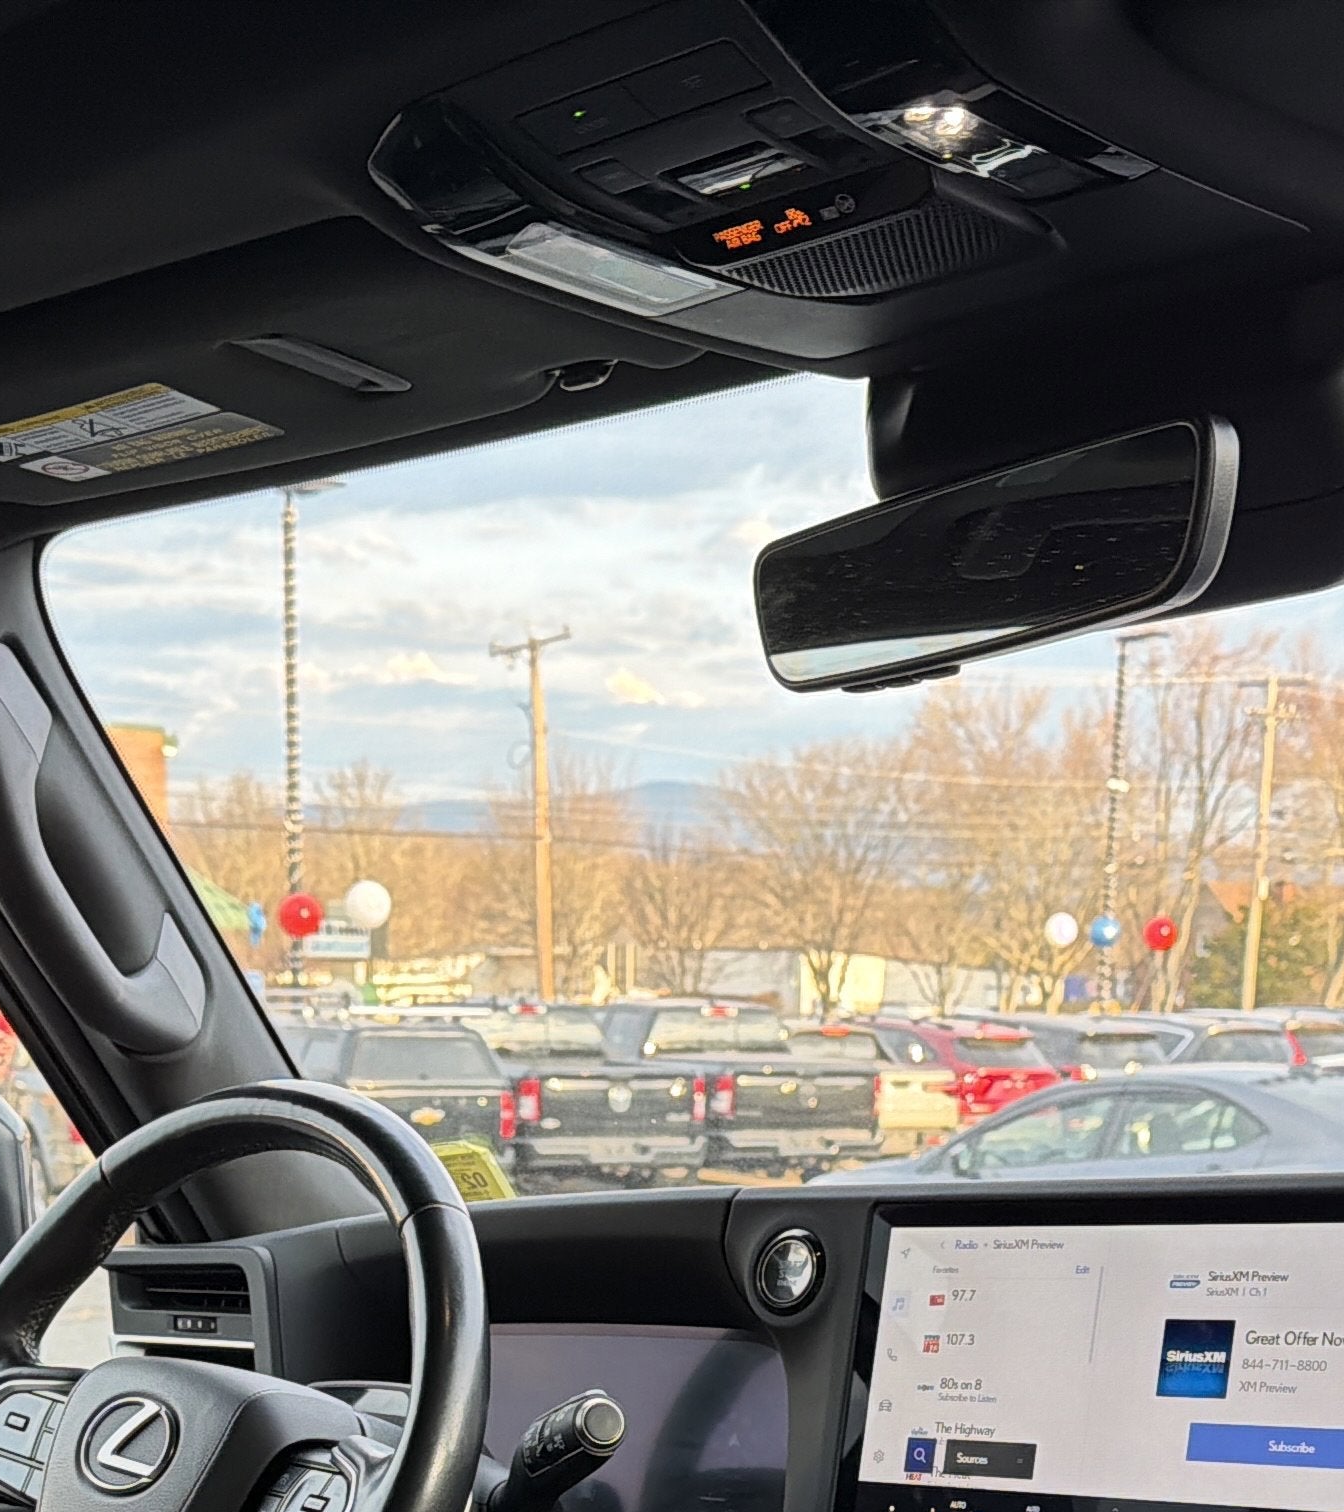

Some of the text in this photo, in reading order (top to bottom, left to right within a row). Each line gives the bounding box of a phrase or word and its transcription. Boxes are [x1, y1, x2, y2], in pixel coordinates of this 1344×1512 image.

[773, 220, 792, 234] OFF
[955, 1239, 1064, 1250] Radio SiriusXM Preview
[1075, 1265, 1090, 1275] Edit
[1207, 1271, 1250, 1282] SiriusXM
[1251, 1271, 1289, 1282] Preview
[952, 1289, 976, 1302] 97.7
[1206, 1287, 1239, 1297] SiriusXM
[1249, 1287, 1261, 1297] Ch
[946, 1333, 975, 1346] 107.3
[1245, 1330, 1280, 1345] Great
[1284, 1330, 1319, 1346] Offer
[1166, 1349, 1227, 1364] SiriusXM
[1241, 1358, 1327, 1372] 844-711-8800
[940, 1377, 959, 1390] 80s
[960, 1382, 972, 1390] on
[974, 1378, 982, 1390] 8
[1238, 1381, 1298, 1394] XM Preview
[937, 1392, 996, 1403] Subscribe to Listen
[935, 1422, 952, 1434] The
[954, 1423, 996, 1438] Highway
[1268, 1440, 1315, 1454] Subscribe
[956, 1452, 988, 1465] Sources
[949, 1500, 967, 1510] AUTO
